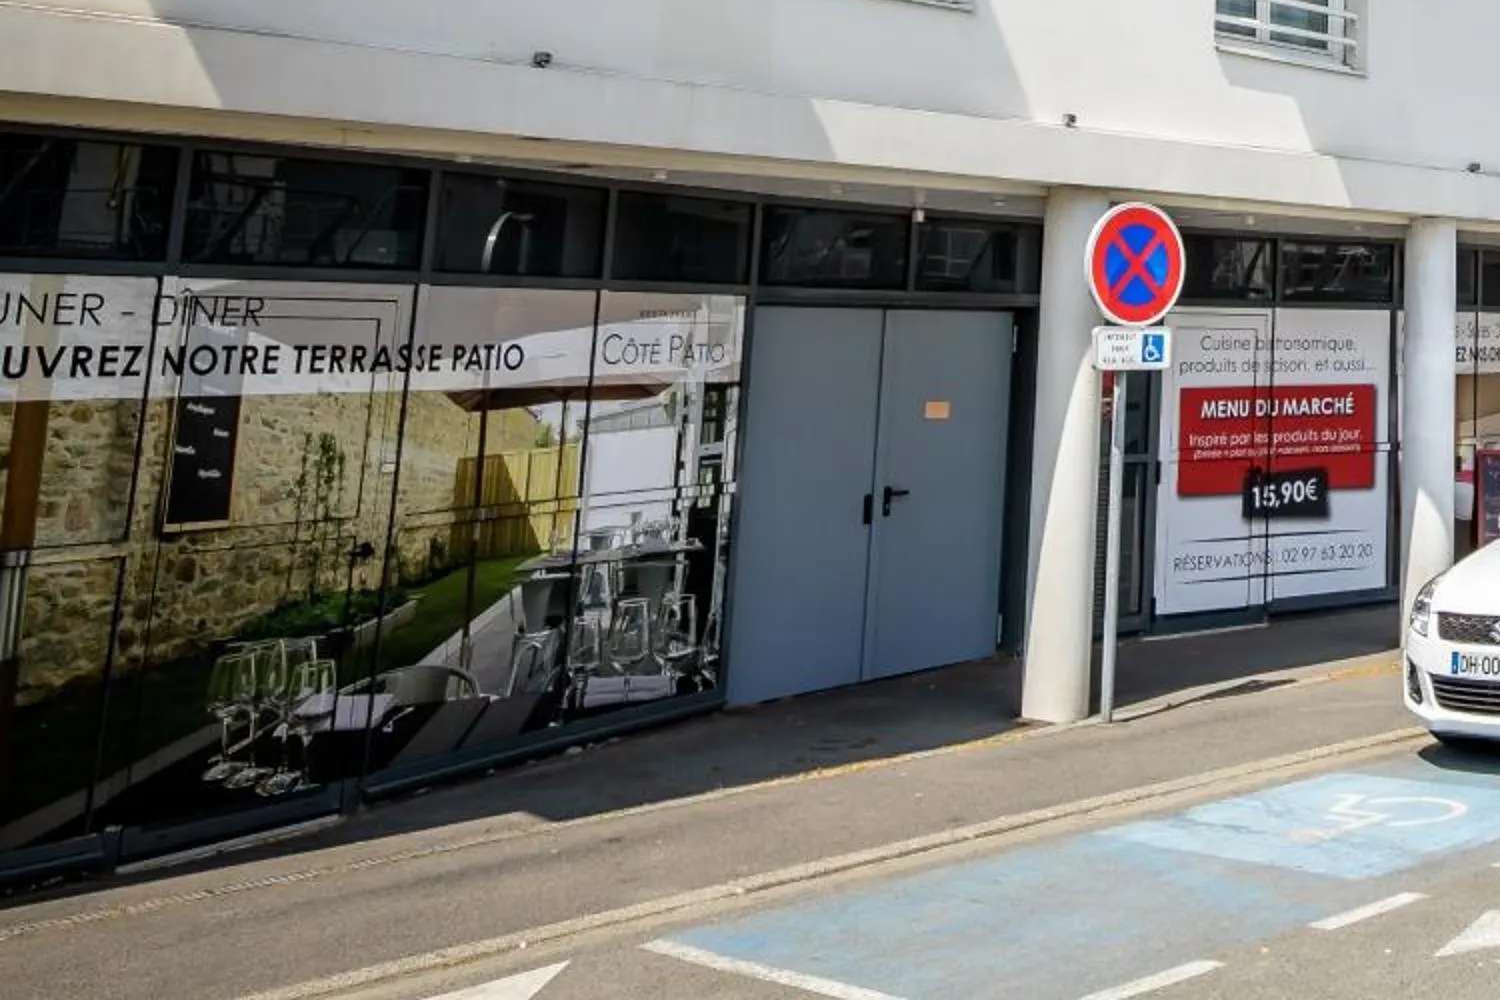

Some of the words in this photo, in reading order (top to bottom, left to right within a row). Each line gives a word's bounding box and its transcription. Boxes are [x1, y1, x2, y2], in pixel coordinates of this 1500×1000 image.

[1200, 335, 1250, 351] Cuisine
[162, 344, 280, 376] NOTRE
[293, 343, 442, 374] TERRASSE
[452, 343, 525, 371] PATIO
[1179, 357, 1236, 376] produits
[1201, 400, 1249, 419] MENU
[1255, 398, 1279, 417] DU
[1283, 391, 1354, 416] MARCHÉ
[1273, 429, 1318, 445] produits
[1321, 427, 1336, 441] du
[1252, 477, 1318, 508] 15,90€
[1282, 549, 1297, 564] 02
[1301, 547, 1317, 563] 97
[1339, 545, 1355, 560] 20
[1358, 543, 1373, 558] 20
